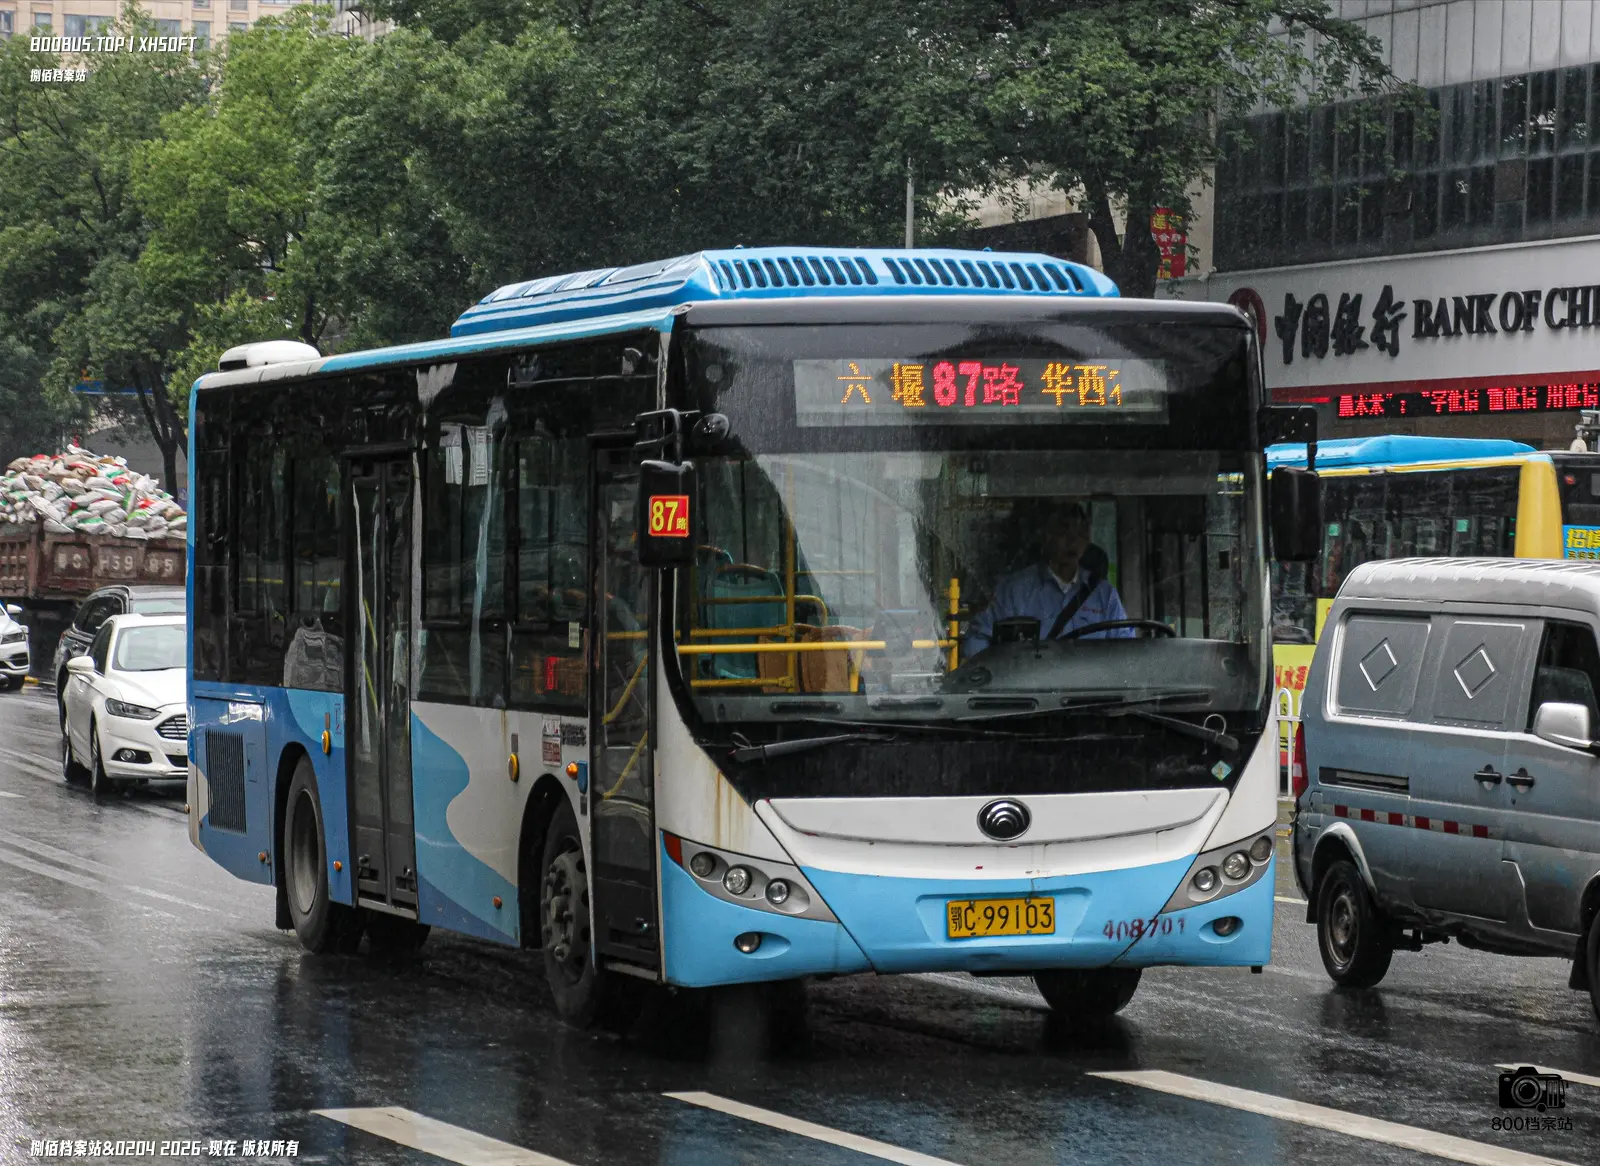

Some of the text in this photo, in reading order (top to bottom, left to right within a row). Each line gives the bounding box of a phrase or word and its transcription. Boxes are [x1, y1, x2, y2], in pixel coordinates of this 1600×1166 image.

[1411, 293, 1498, 339] BANK
[1499, 289, 1542, 333] OF
[1102, 917, 1185, 942] 408701
